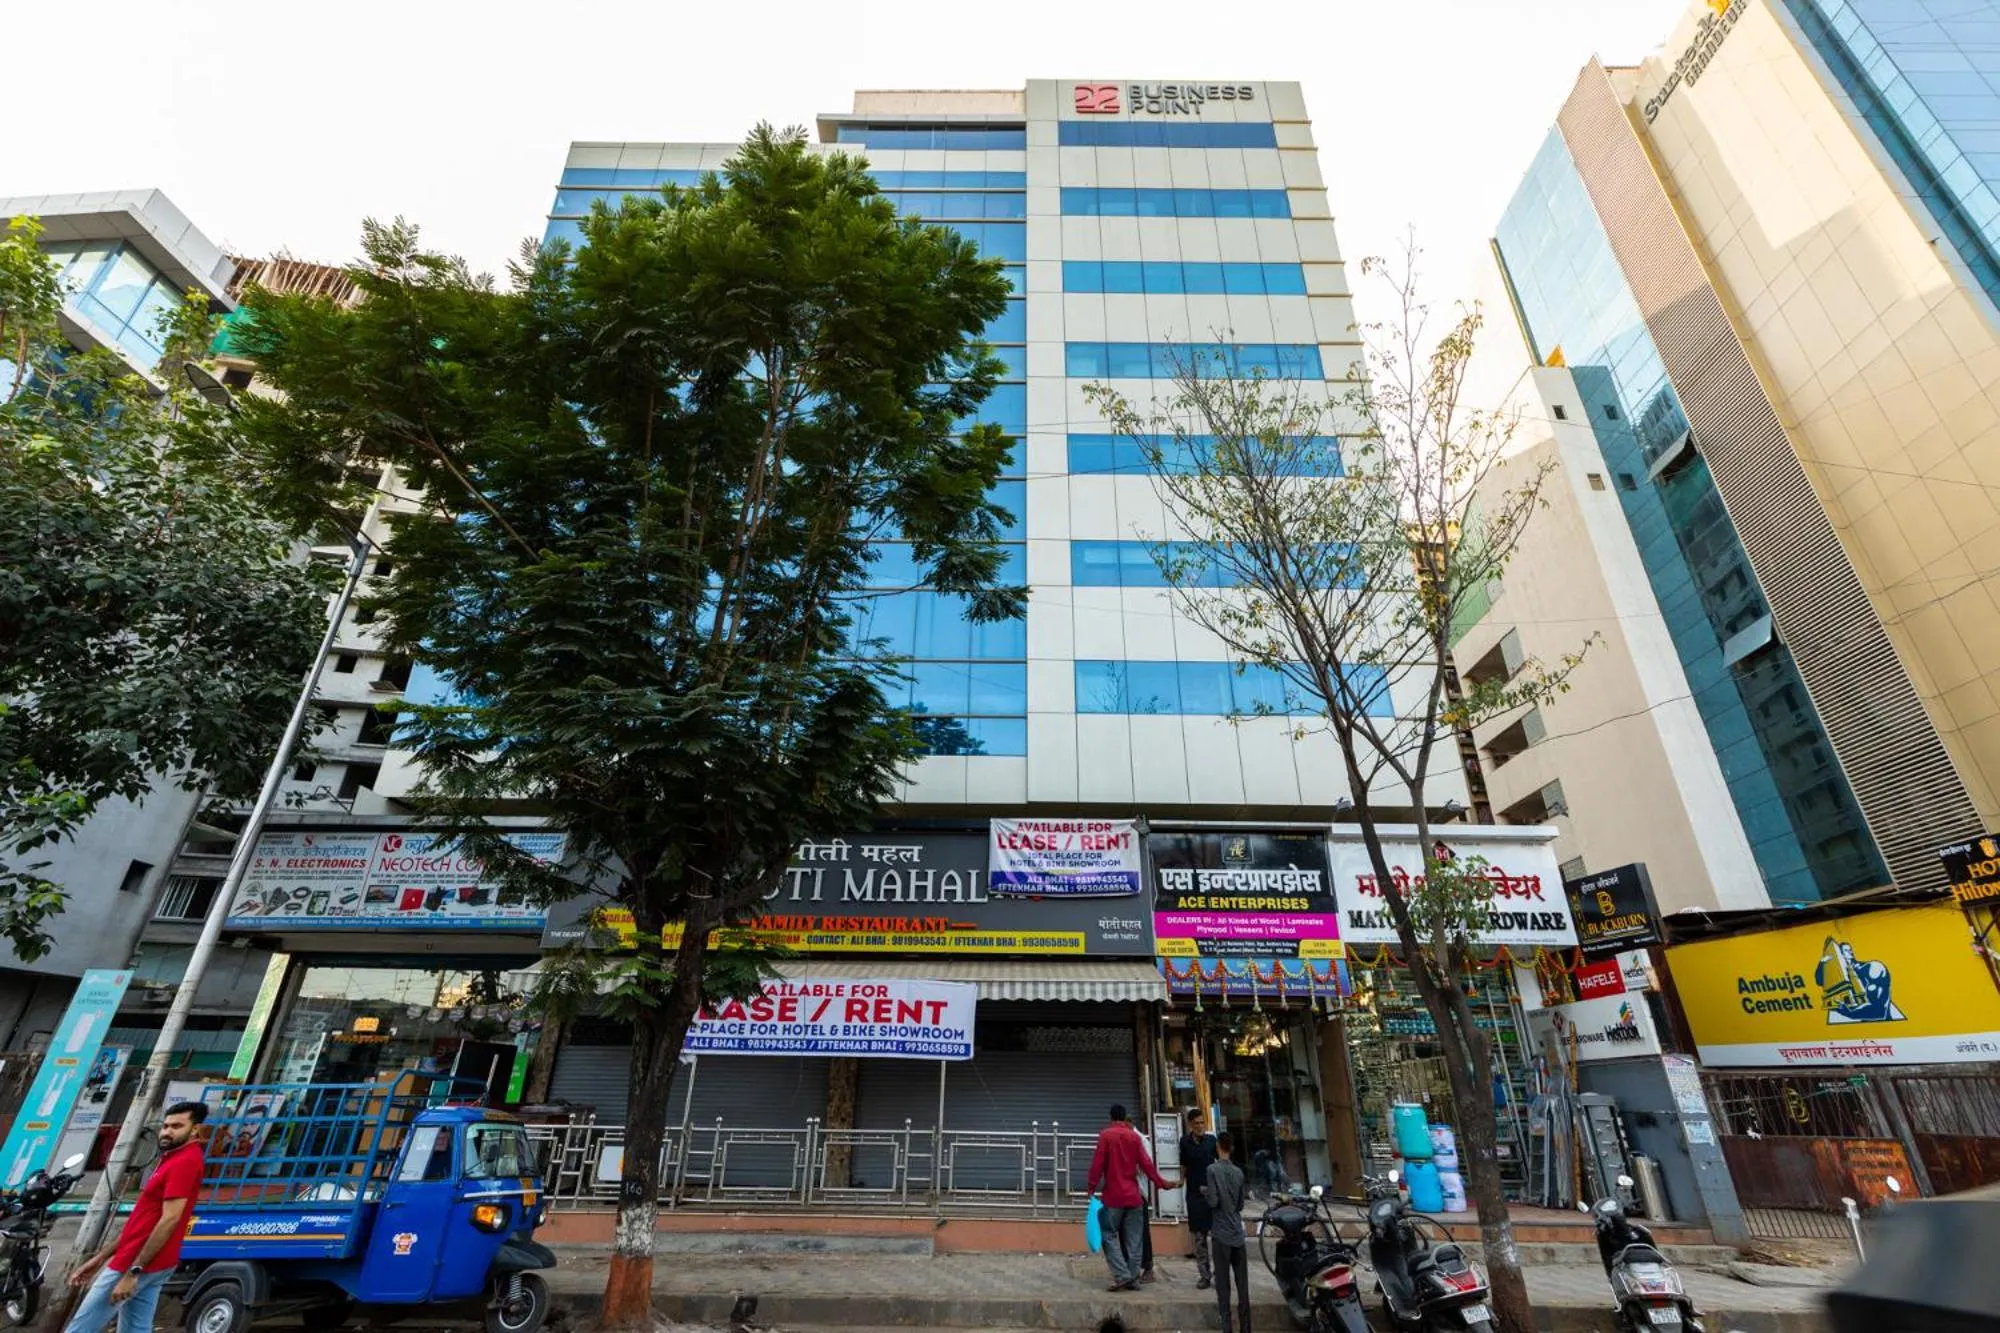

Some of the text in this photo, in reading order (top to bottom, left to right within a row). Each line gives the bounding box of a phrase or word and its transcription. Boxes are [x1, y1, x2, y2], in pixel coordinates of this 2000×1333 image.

[1075, 84, 1254, 115] 22 BUSINESS
[1130, 100, 1204, 115] POINT
[1017, 822, 1112, 833] AVAILABLE FOR
[997, 832, 1058, 851] LEASE
[1080, 832, 1132, 851] RENT
[861, 845, 923, 865] महल
[1055, 852, 1082, 860] PLACE
[1085, 852, 1103, 860] FOR
[286, 859, 368, 868] ELECTRONICS
[379, 857, 451, 872] NEOTECH
[1068, 860, 1121, 868] SHOWROOM
[841, 868, 989, 903] MAHAL
[1027, 875, 1042, 884] ALI
[1045, 875, 1068, 885] BHAI
[1160, 868, 1193, 890] एस
[1045, 884, 1068, 893] BHAI
[1178, 896, 1310, 909] ACE ENTERPRISES
[821, 915, 949, 933] RESTAURANT
[1166, 916, 1202, 924] DEALERS
[1587, 911, 1647, 936] BLACKBURN
[1197, 926, 1227, 935] Plywood
[807, 935, 845, 945] CONTACT
[851, 935, 864, 945] ALI
[1738, 971, 1806, 994] Ambuja
[851, 984, 888, 998] FOR
[1741, 993, 1815, 1014] Cement
[844, 998, 948, 1026] RENT
[700, 1023, 745, 1036] PLACE
[750, 1024, 778, 1036] FOR
[782, 1024, 826, 1037] HOTEL
[843, 1025, 878, 1038] BIKE
[881, 1025, 965, 1041] SHOWROOM
[690, 1038, 710, 1048] ALI
[711, 1039, 739, 1048] BHAI
[747, 1039, 807, 1050] 9819943543
[817, 1040, 869, 1050] IFTEKHAR
[871, 1041, 896, 1051] BHAI
[904, 1042, 966, 1055] 9930658598
